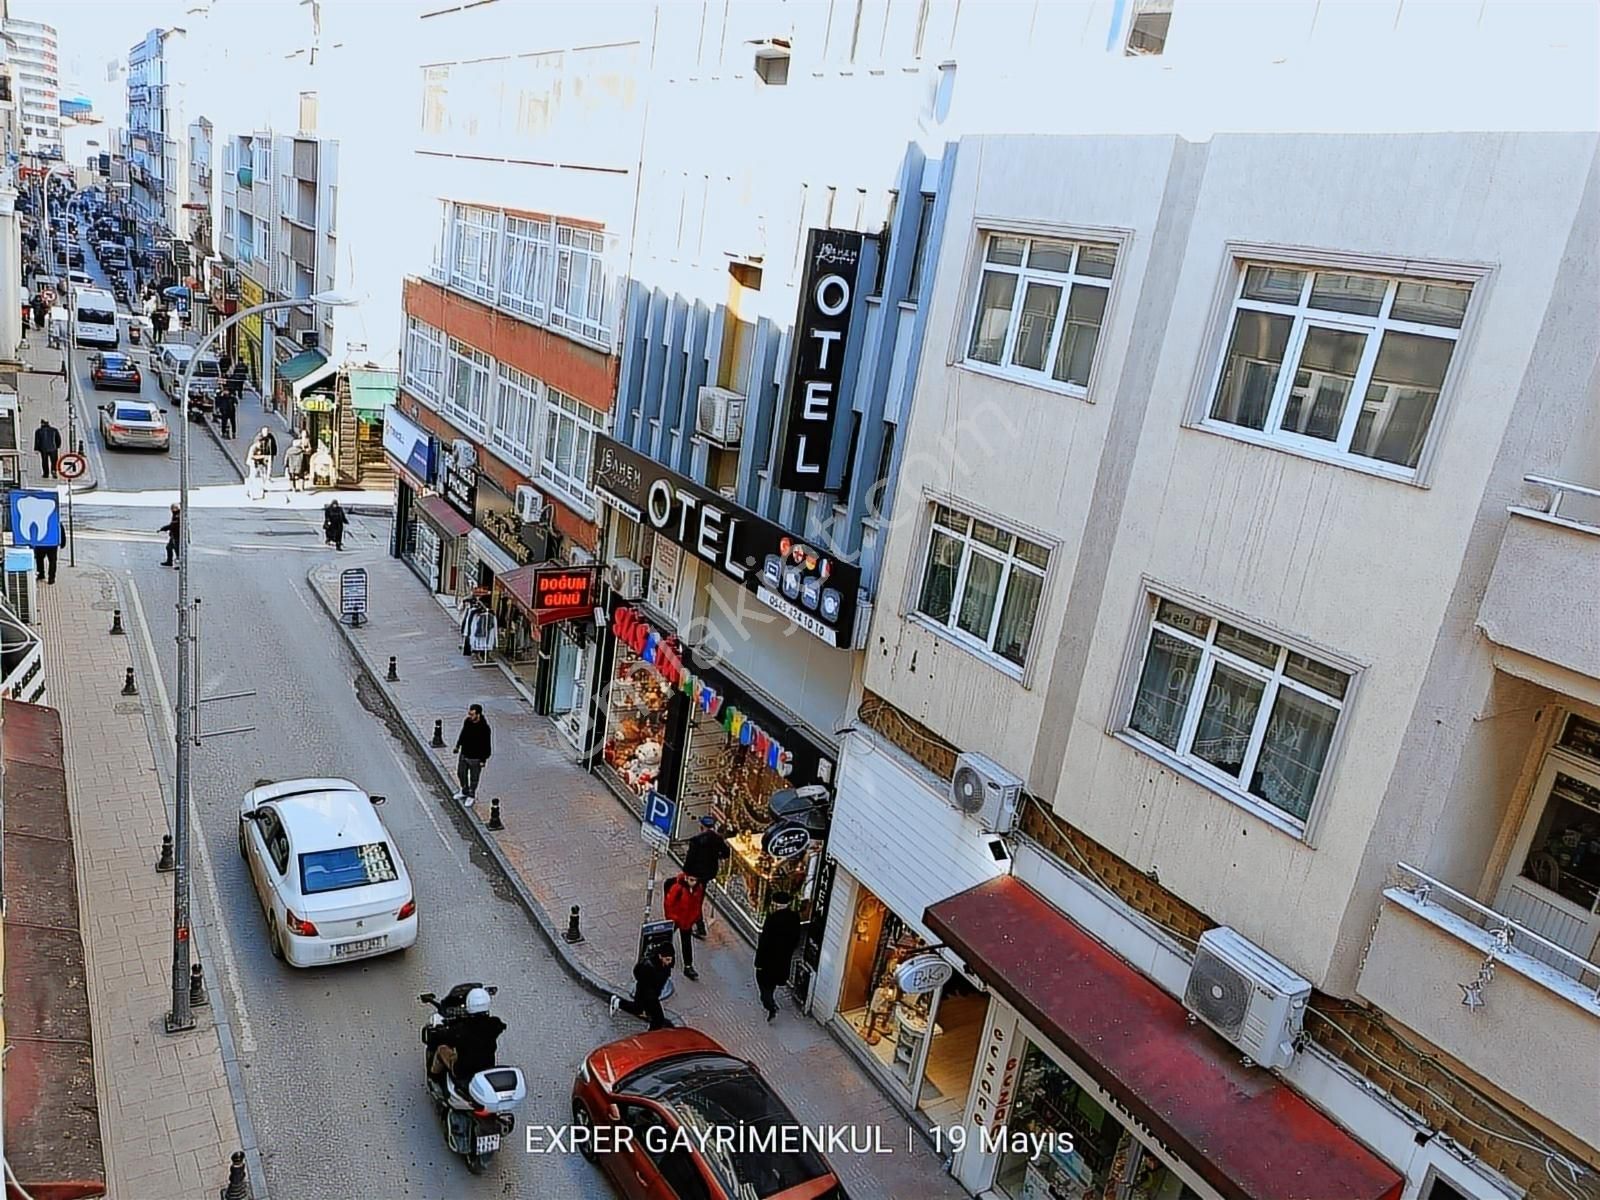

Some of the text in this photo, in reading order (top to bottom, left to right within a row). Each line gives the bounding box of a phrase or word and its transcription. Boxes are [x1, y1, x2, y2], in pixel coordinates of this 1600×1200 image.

[796, 273, 850, 473] OTEL
[648, 478, 748, 581] OTEL
[540, 573, 587, 592] DOĞUM
[544, 590, 581, 606] GÜNÜ
[803, 615, 814, 630] 10
[814, 624, 826, 637] 10
[650, 799, 669, 822] P
